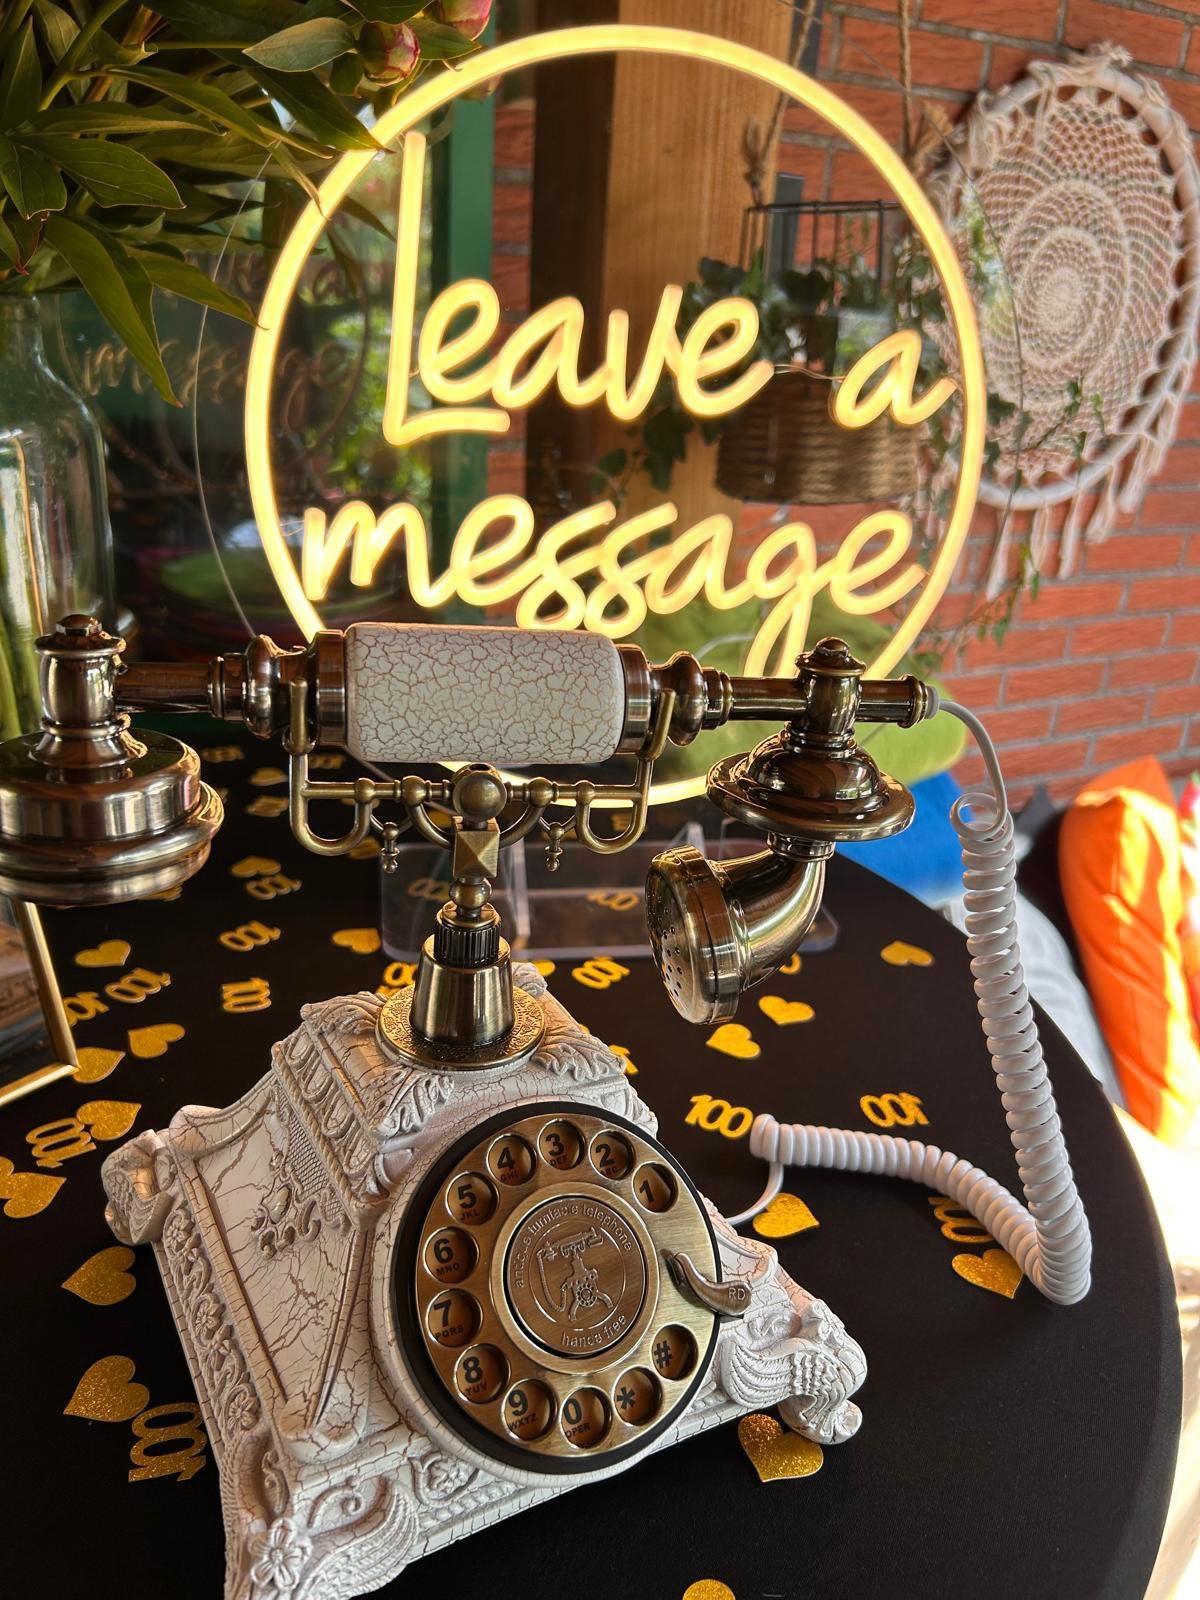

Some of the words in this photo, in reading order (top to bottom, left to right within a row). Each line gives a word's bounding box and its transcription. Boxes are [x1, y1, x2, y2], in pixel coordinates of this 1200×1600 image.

[382, 132, 774, 446] Leave
[832, 329, 956, 427] a
[303, 494, 929, 677] message
[684, 1093, 753, 1140] 100
[545, 1133, 565, 1156] 3
[595, 1143, 614, 1168] 2
[497, 1147, 515, 1170] 4
[457, 1183, 478, 1208] 5
[639, 1180, 655, 1203] 1
[460, 1209, 480, 1221] JKL
[433, 1238, 453, 1264] 6
[435, 1262, 460, 1276] MNO
[728, 1287, 747, 1301] RD
[433, 1300, 452, 1327] 7
[434, 1324, 464, 1341] PQRS
[603, 1314, 626, 1341] free
[463, 1356, 483, 1384] 8
[465, 1382, 488, 1396] TUV
[508, 1389, 529, 1417] 9
[563, 1397, 582, 1425] 0
[508, 1413, 538, 1430] WXYZ
